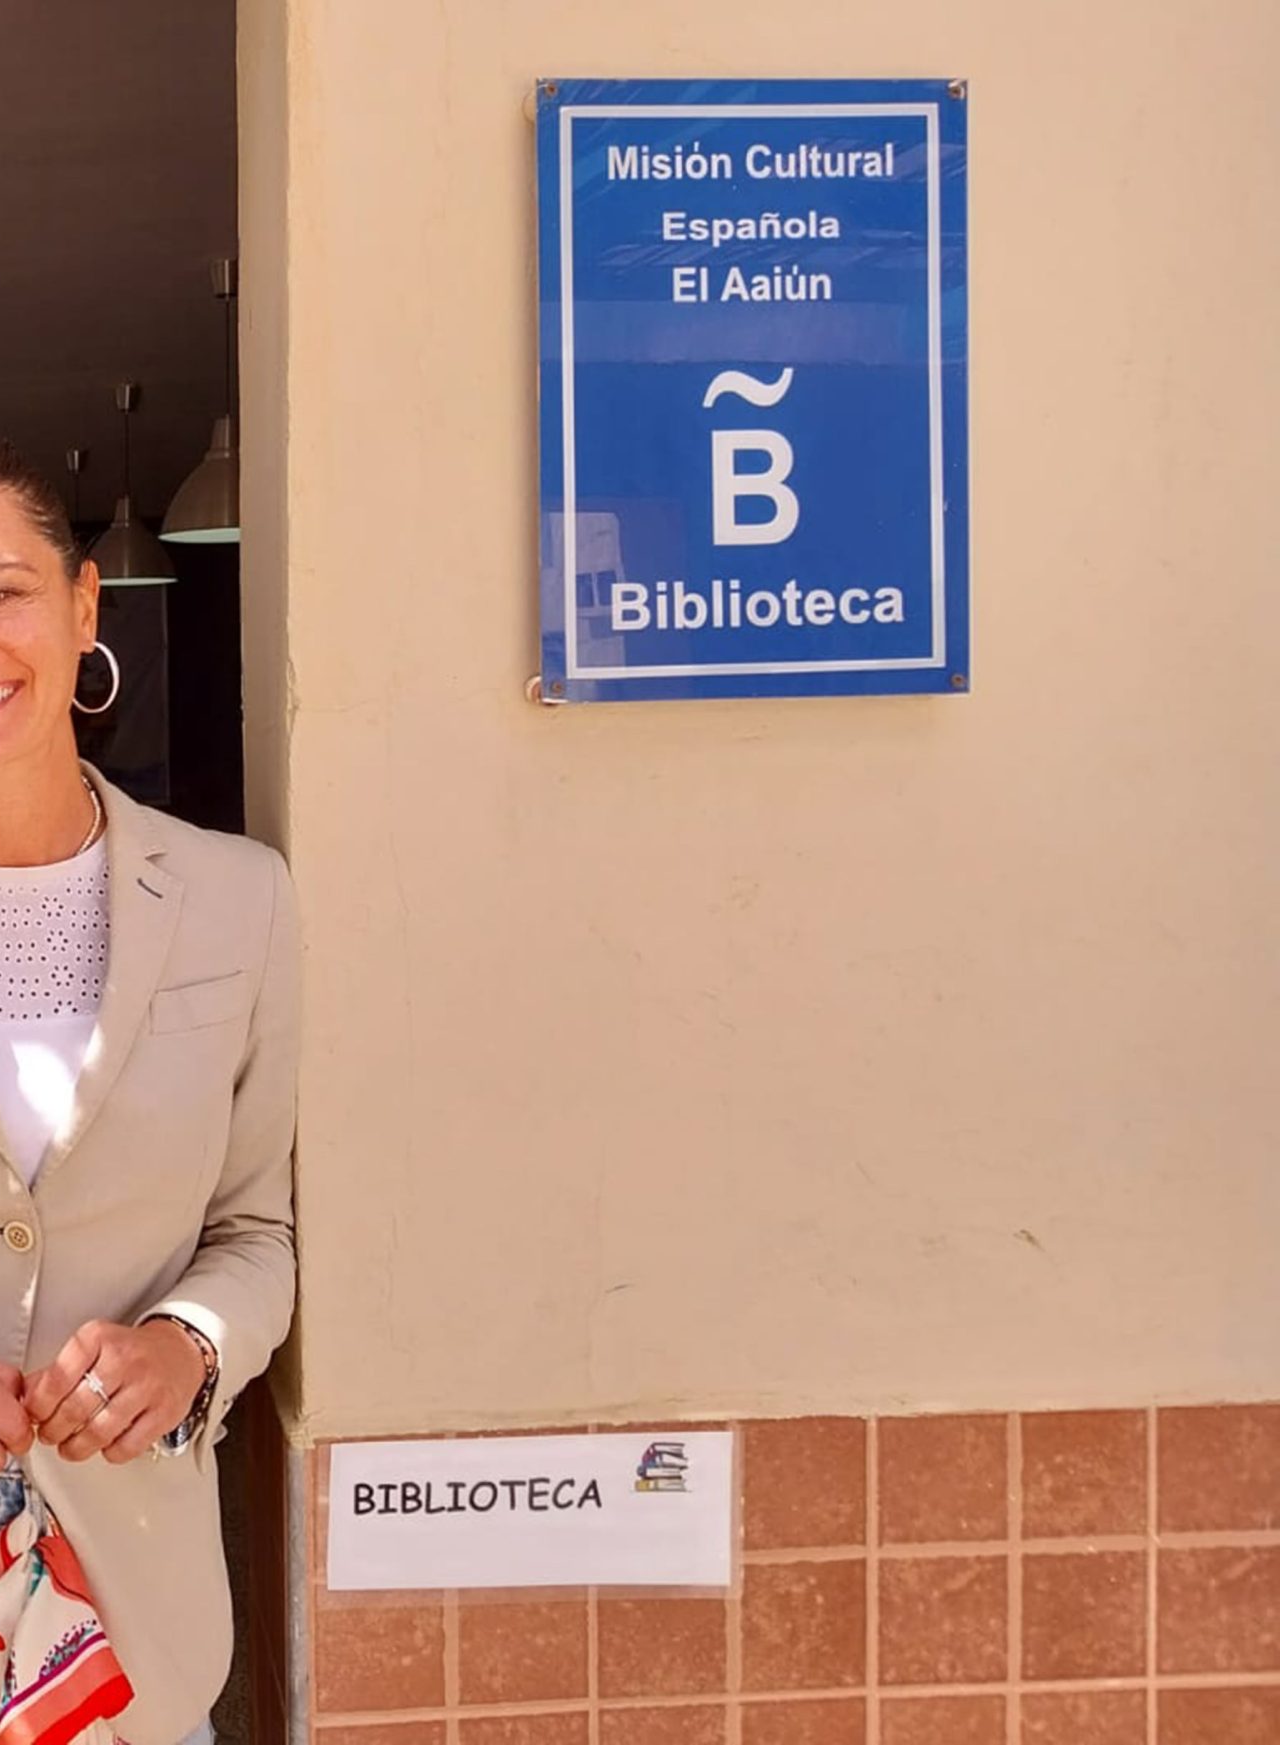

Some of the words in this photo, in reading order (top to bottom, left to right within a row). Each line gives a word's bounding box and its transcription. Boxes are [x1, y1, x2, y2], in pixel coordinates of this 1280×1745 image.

[607, 142, 732, 180] Misión
[746, 143, 894, 179] Cultural
[663, 211, 840, 247] Española
[672, 267, 708, 303] El
[720, 265, 832, 302] Aaiún
[611, 579, 904, 631] Biblioteca
[353, 1478, 602, 1515] BIBLIOTECA
